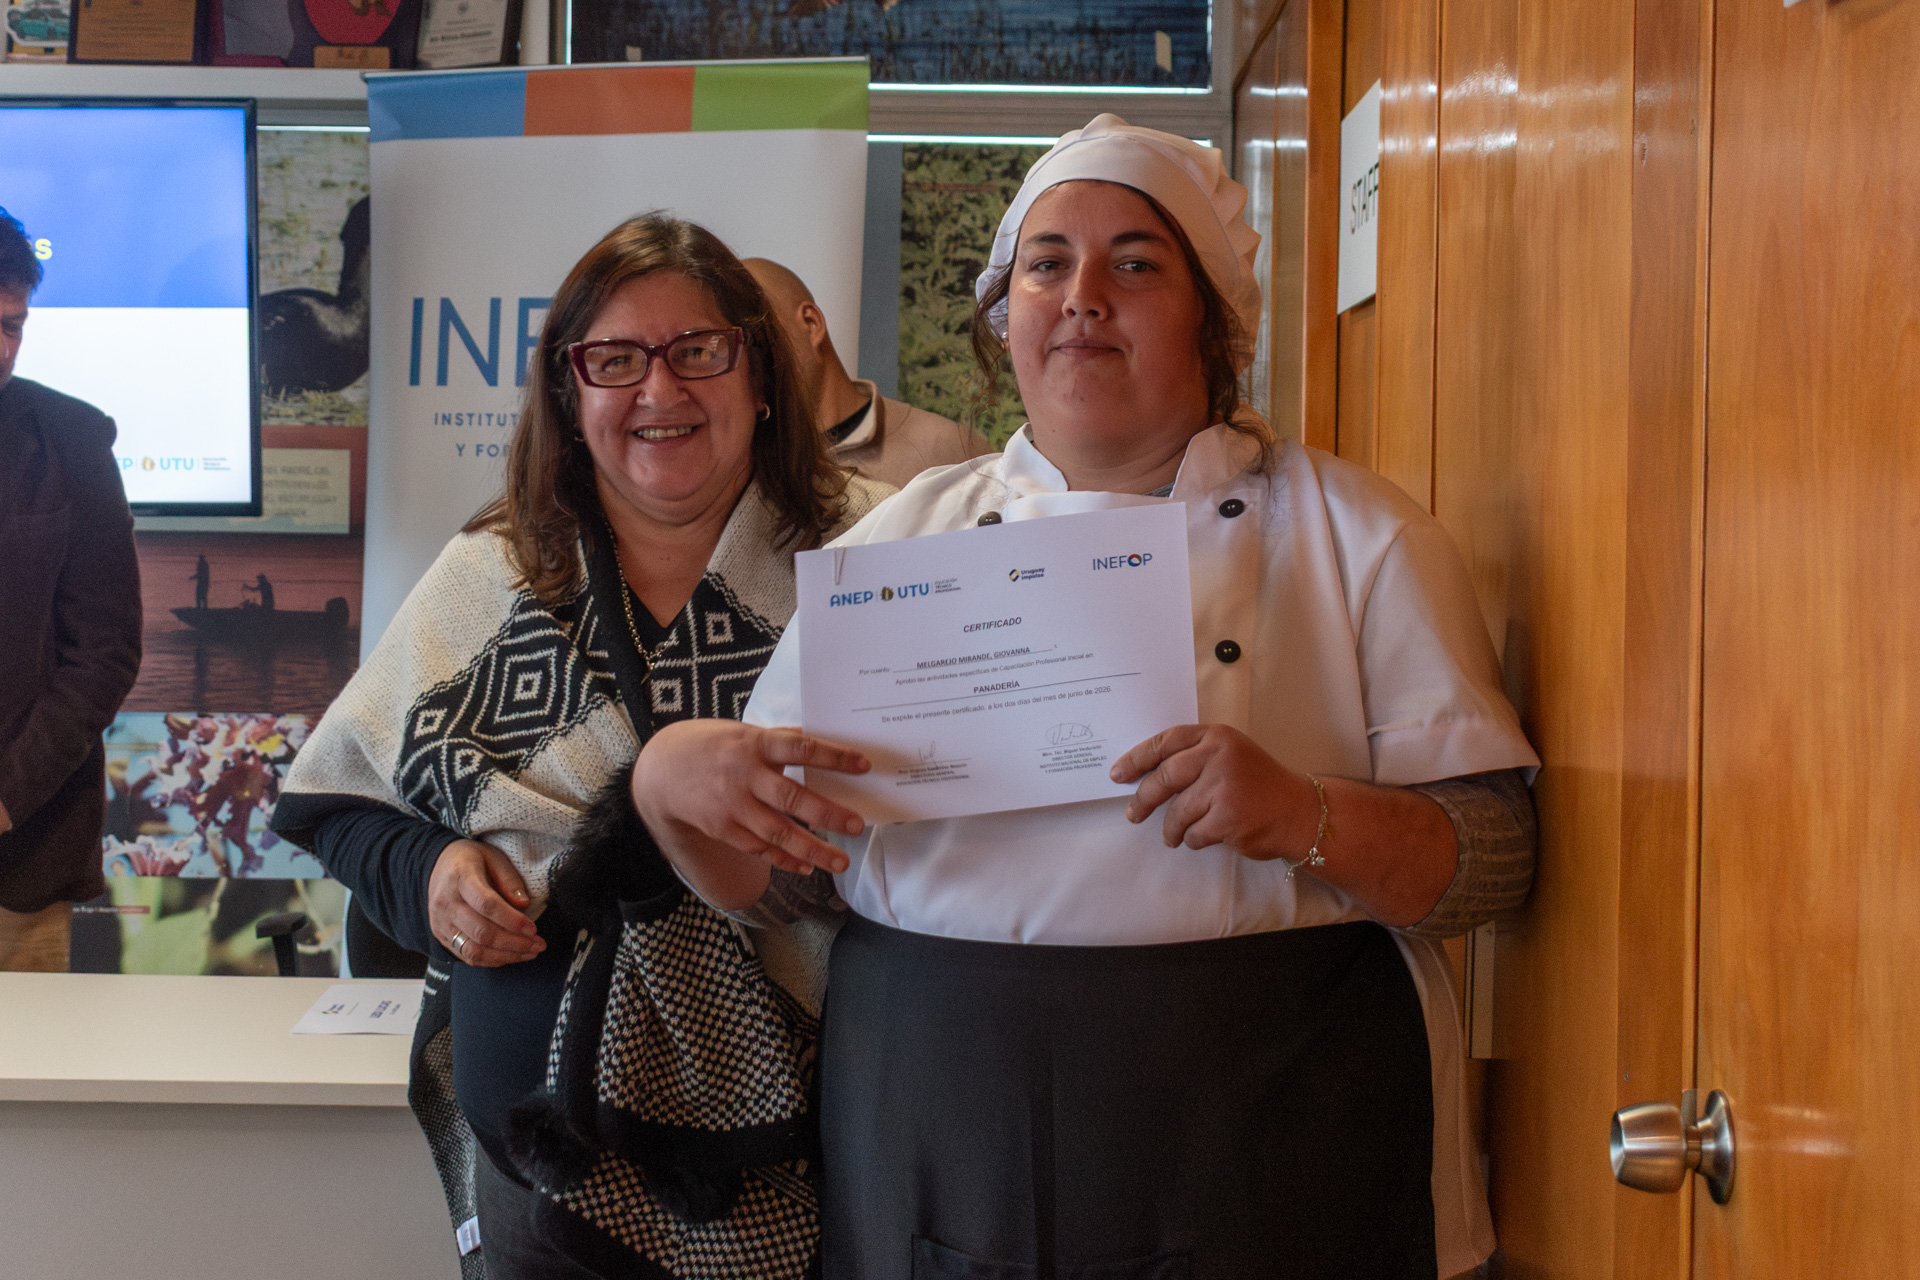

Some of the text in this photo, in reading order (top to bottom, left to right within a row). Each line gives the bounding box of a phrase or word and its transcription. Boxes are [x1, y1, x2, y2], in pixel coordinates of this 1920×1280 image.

[1351, 161, 1379, 235] STAFF
[434, 413, 521, 427] INSTITUT
[456, 443, 466, 457] Y
[160, 457, 194, 471] UTU
[1092, 553, 1153, 571] INEFOP
[1020, 567, 1045, 576] Uruguay
[830, 582, 930, 608] ANEP UTU
[963, 616, 1022, 633] CERTIFICADO
[916, 657, 957, 670] MELGAREJO
[993, 646, 1031, 660] GIOVANNA
[927, 672, 958, 681] actividades
[991, 664, 999, 672] de
[999, 660, 1035, 671] Capacitación
[1035, 655, 1067, 666] Profesional
[1067, 652, 1084, 661] Inicial
[973, 679, 1020, 693] PANADERÍA
[881, 715, 891, 723] Se
[892, 713, 914, 722] expide
[915, 711, 921, 719] el
[922, 709, 951, 719] presente
[993, 701, 1003, 709] los
[1004, 700, 1016, 708] dos
[1032, 695, 1042, 703] del
[1043, 694, 1057, 702] mes
[1058, 691, 1067, 699] de
[1067, 689, 1083, 699] junio
[1084, 688, 1093, 696] de
